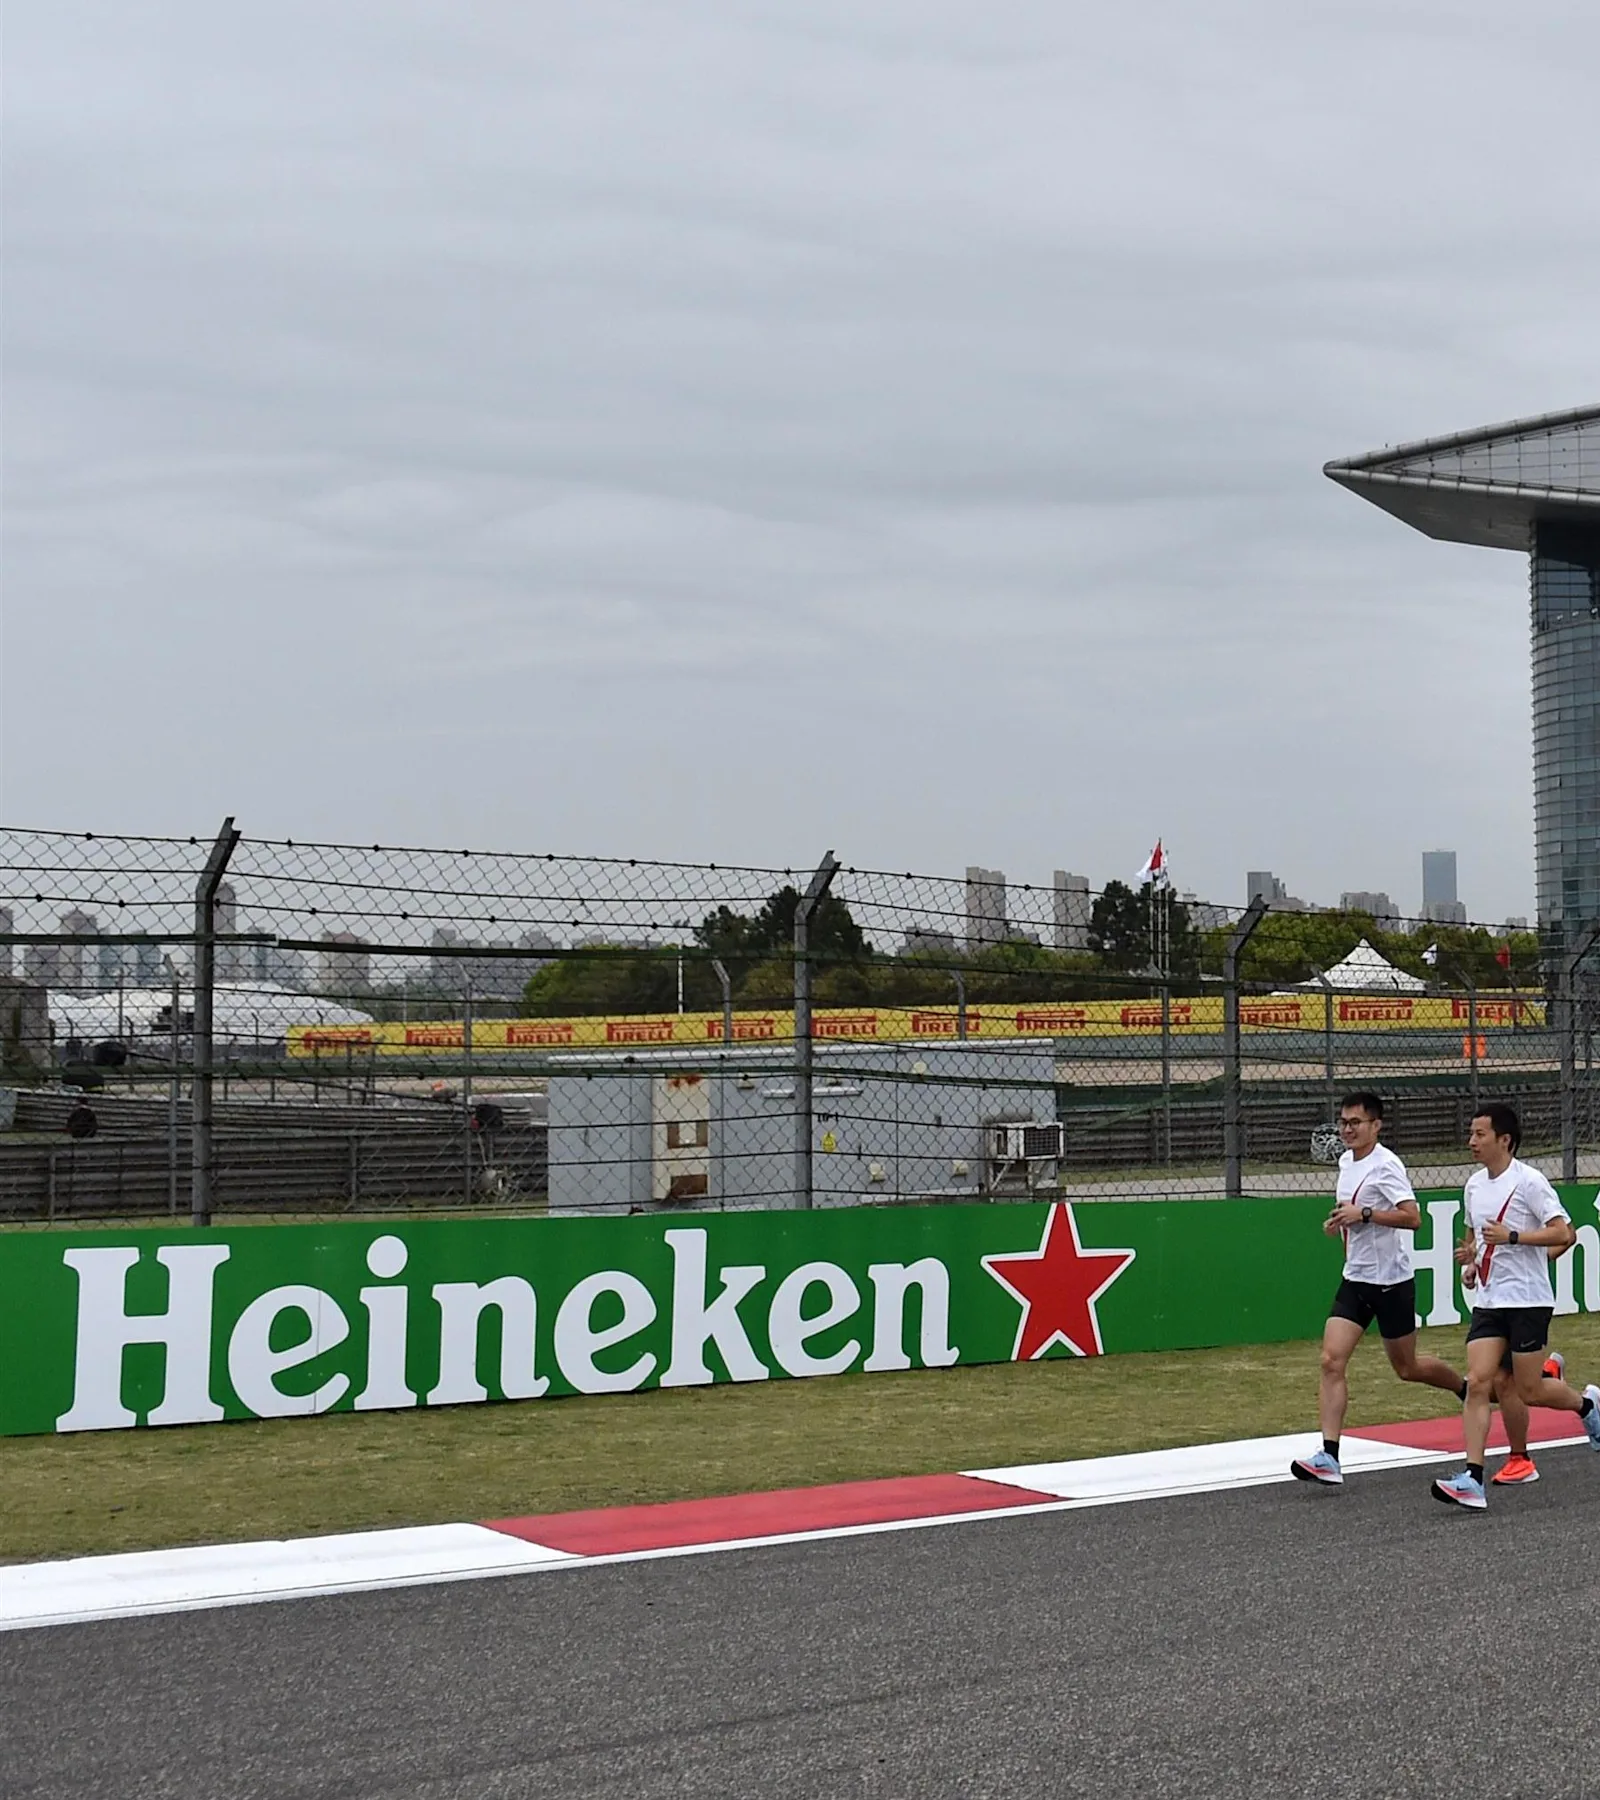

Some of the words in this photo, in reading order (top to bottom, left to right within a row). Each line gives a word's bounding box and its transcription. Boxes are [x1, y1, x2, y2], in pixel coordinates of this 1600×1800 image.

[607, 1022, 673, 1042] PIRELLI
[811, 1016, 877, 1036] PIRELLI
[912, 1013, 981, 1033] PIRELI
[1339, 1000, 1413, 1021] PIRELLI
[57, 1229, 960, 1433] Heineken
